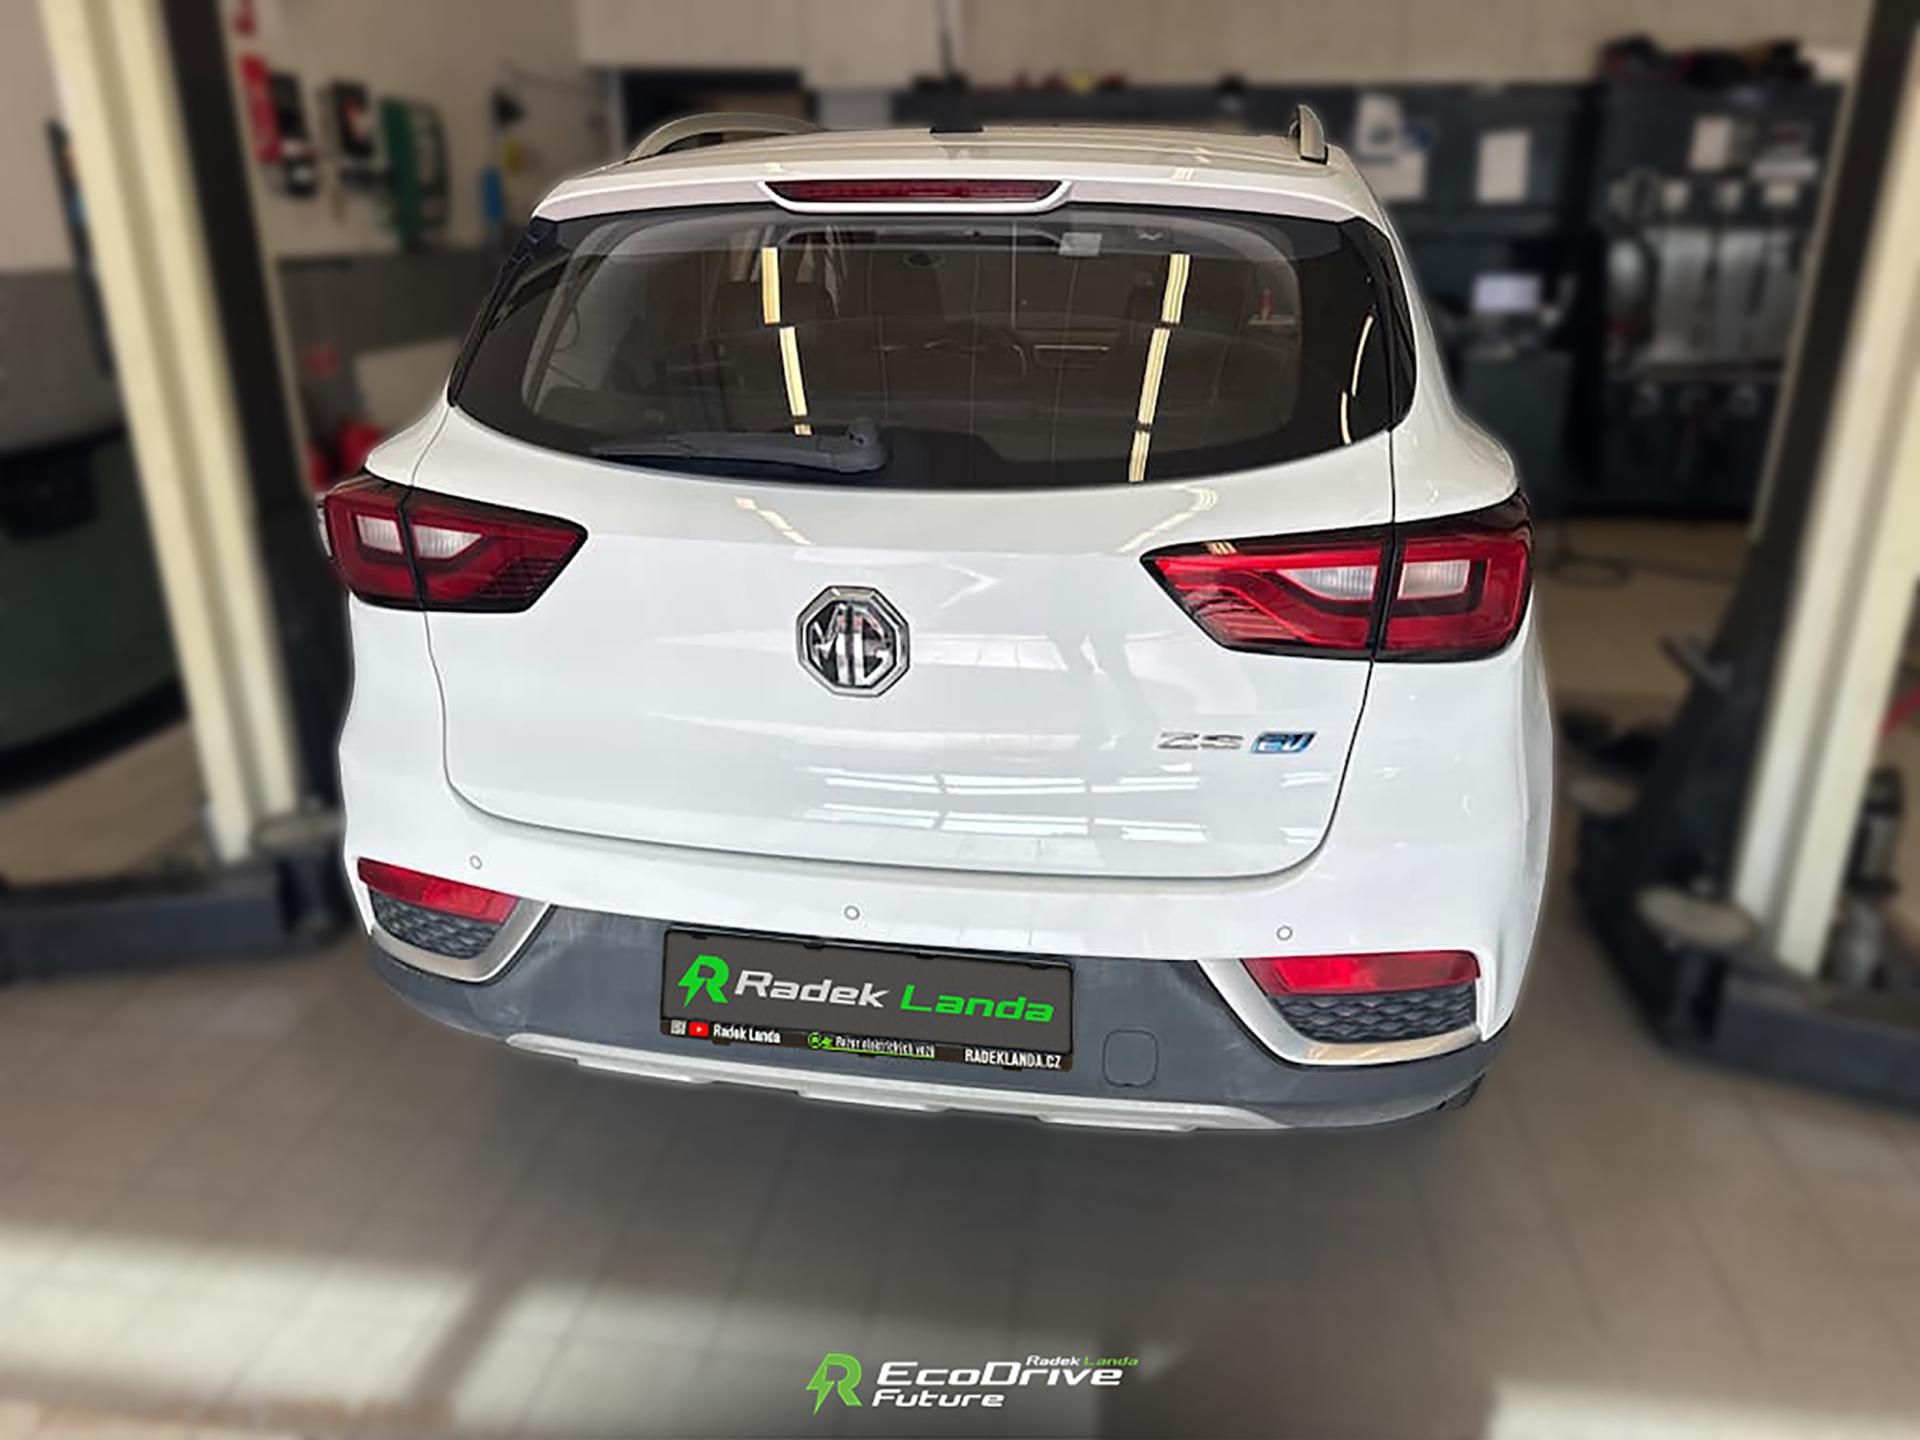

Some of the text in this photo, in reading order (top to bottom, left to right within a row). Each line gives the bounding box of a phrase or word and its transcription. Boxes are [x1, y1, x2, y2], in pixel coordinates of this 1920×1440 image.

[803, 597, 899, 690] MG
[1157, 732, 1245, 751] ZS
[734, 969, 890, 1008] Radek
[900, 984, 1055, 1023] Landa
[713, 1023, 781, 1044] Radek Landa
[964, 1048, 1062, 1070] RADEKLANDA.CZ
